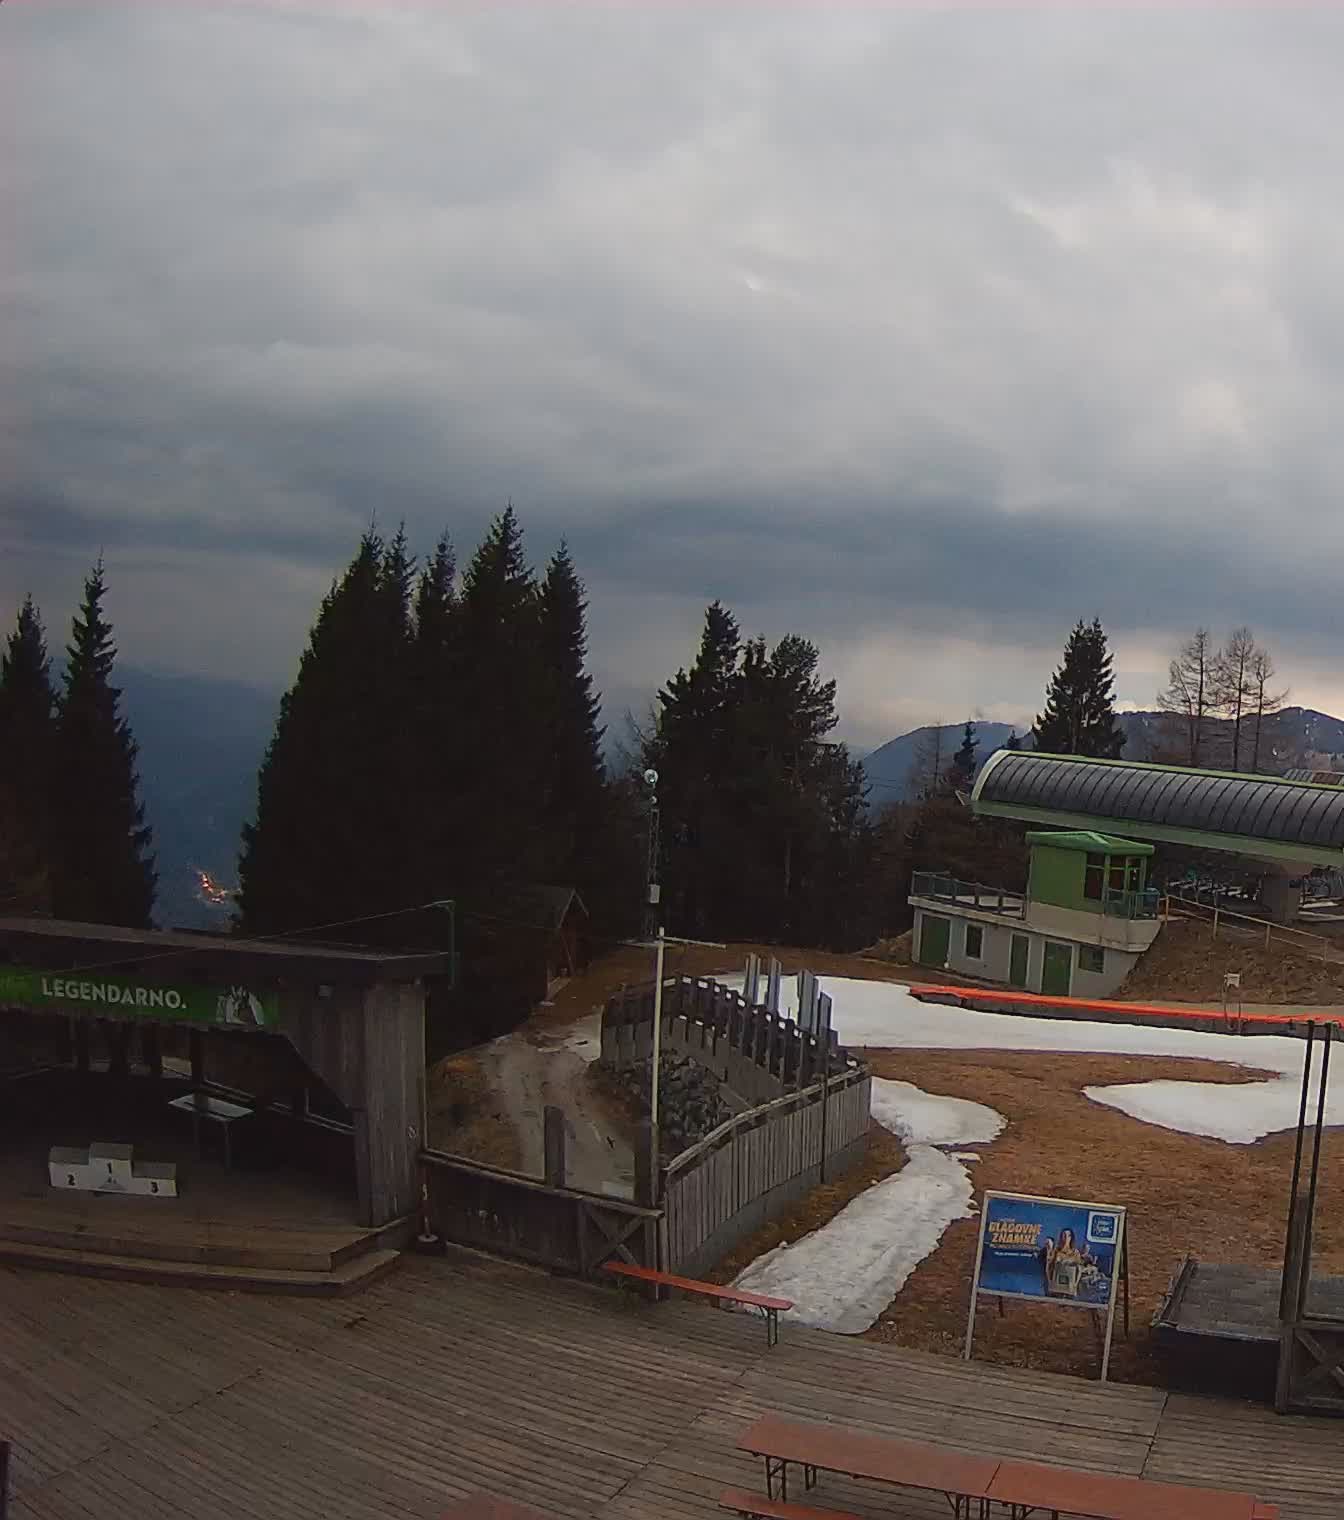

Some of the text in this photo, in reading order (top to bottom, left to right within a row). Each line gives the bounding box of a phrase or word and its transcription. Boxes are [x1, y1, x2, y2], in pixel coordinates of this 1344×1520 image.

[41, 978, 187, 1009] LEGENDARNO.
[66, 1174, 76, 1186] 2
[150, 1181, 160, 1193] 3
[991, 1232, 1038, 1244] ZNAMKE
